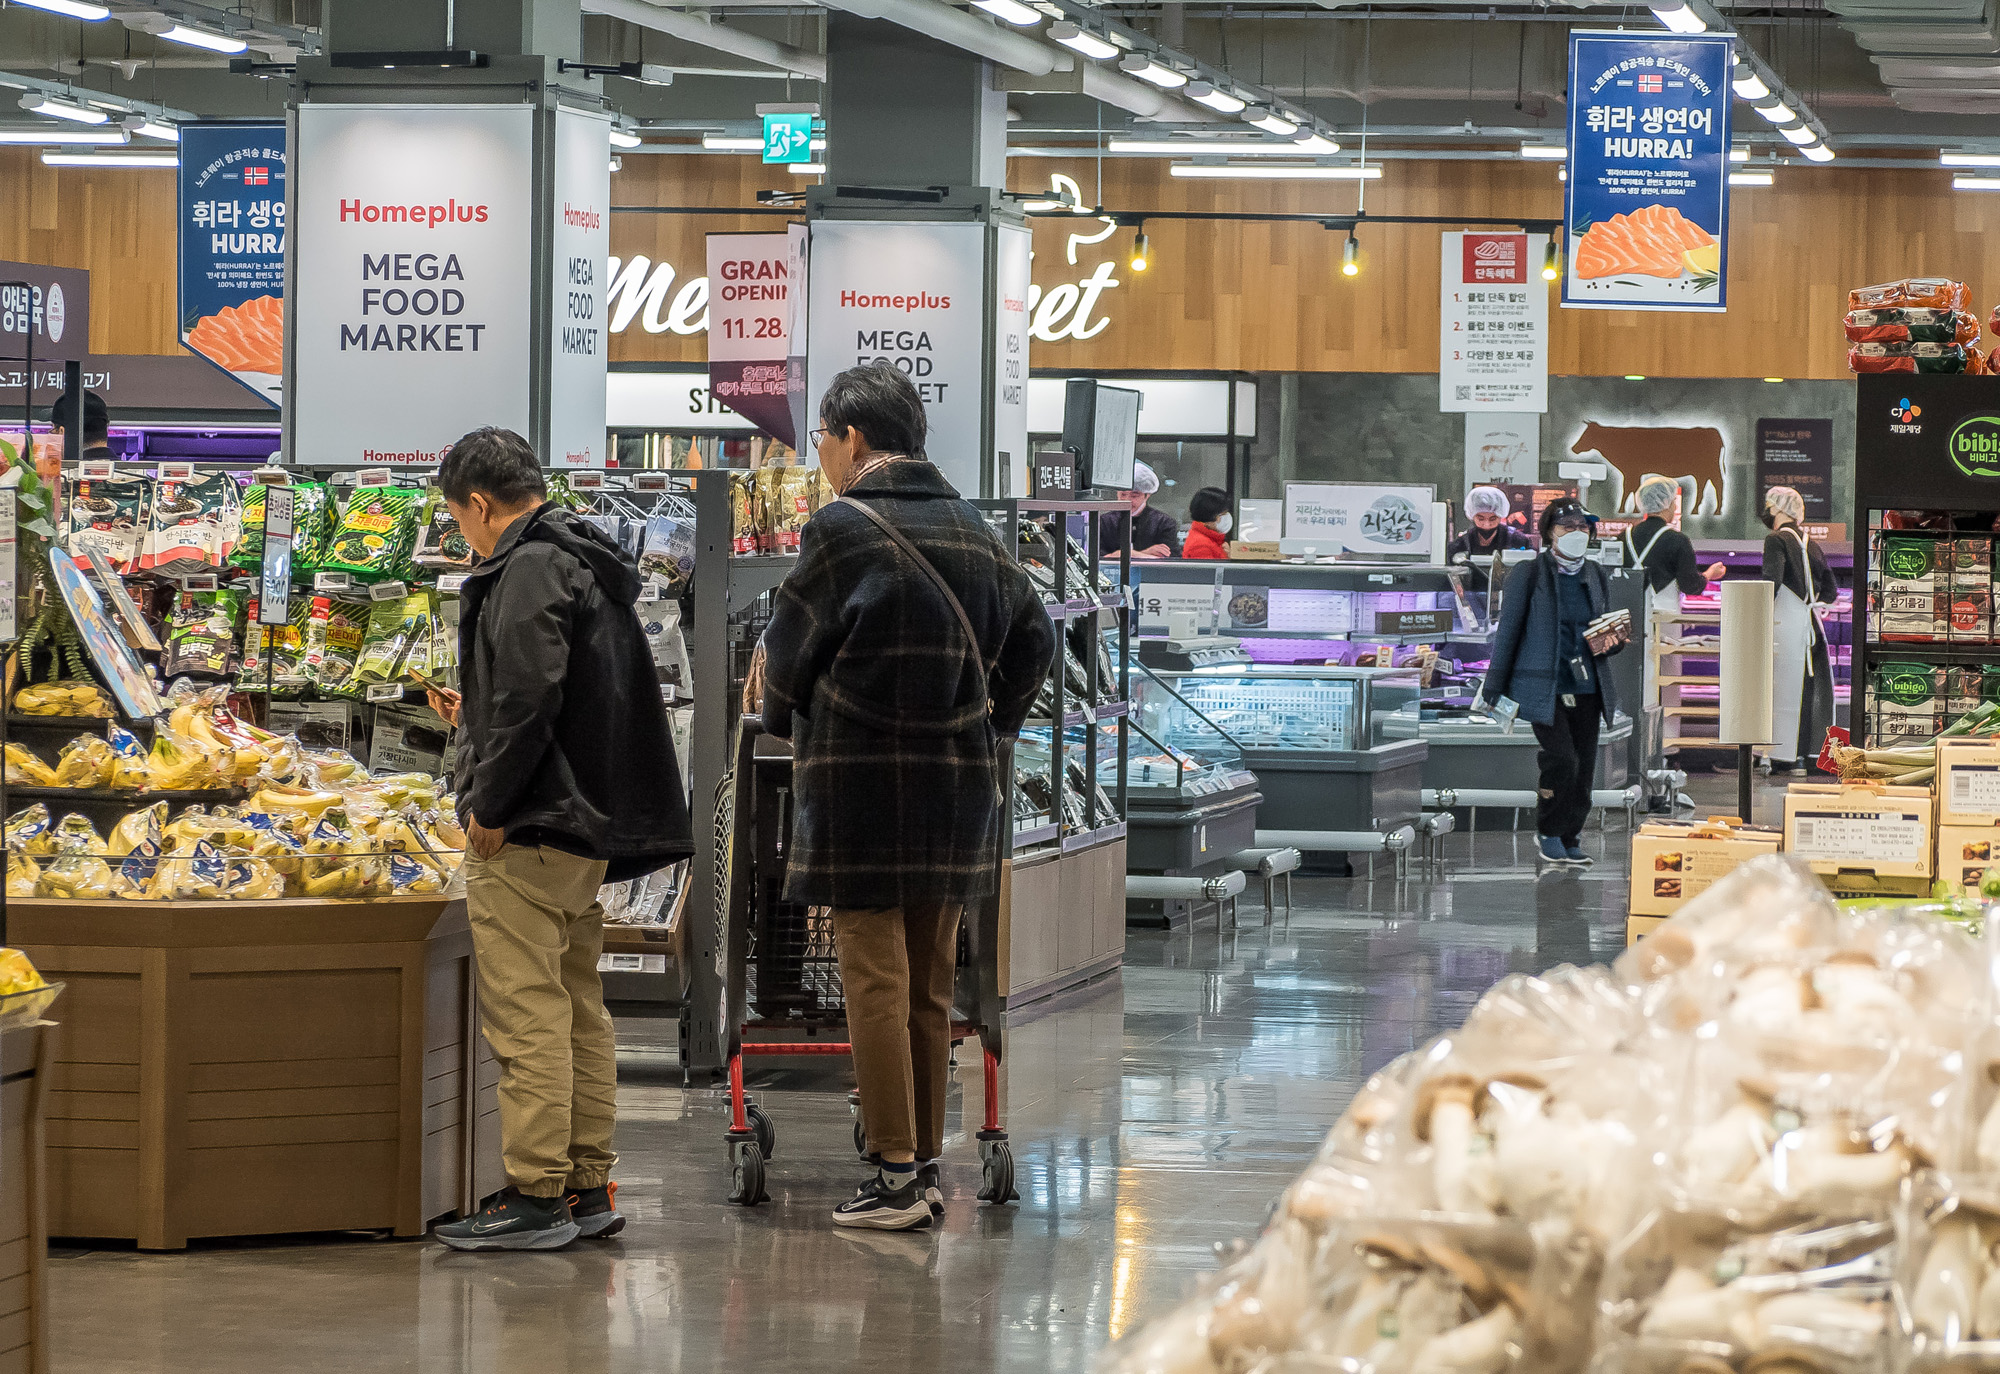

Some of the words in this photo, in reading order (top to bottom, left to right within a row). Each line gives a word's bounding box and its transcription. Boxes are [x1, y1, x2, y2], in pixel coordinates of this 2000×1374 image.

[1590, 65, 1621, 94] 노르웨이
[1619, 56, 1655, 72] 항공직송
[1656, 57, 1691, 78] 콜드체인
[1689, 73, 1711, 97] 생연어
[1586, 105, 1636, 133] 휘라
[1639, 107, 1712, 136] 생연어
[1604, 137, 1693, 159] HURRA!
[195, 158, 225, 188] 노르웨이
[224, 148, 260, 163] 항공직송
[192, 200, 242, 229] 휘라
[339, 198, 489, 229] Homeplus
[564, 202, 600, 233] Homeplus
[363, 253, 465, 281] MEGA
[568, 257, 593, 286] MEGA
[720, 260, 788, 281] GRAN
[362, 288, 465, 316] FOOD
[607, 255, 710, 335] Me
[840, 290, 951, 313] Homeplus
[1454, 293, 1463, 302] 1.
[1468, 292, 1485, 302] 클럽
[1488, 292, 1506, 302] 단독
[1509, 292, 1526, 302] 할인
[568, 292, 593, 320] FOOD
[1453, 321, 1464, 331] 2.
[1468, 321, 1485, 331] 클럽
[1488, 321, 1505, 331] 전용
[1508, 321, 1534, 331] 이벤트
[340, 323, 486, 351] MARKET
[562, 328, 598, 356] MARKET
[857, 330, 933, 351] MEGA
[1454, 350, 1464, 360] 3.
[1467, 350, 1493, 360] 다양한
[1497, 350, 1514, 360] 정보
[1517, 350, 1534, 360] 제공
[717, 381, 739, 396] 메가
[740, 381, 763, 396] 푸드
[1891, 407, 1904, 418] CJ
[1890, 424, 1922, 434] 제일제당
[1958, 432, 2000, 452] bibi
[363, 449, 436, 465] Homeplus
[1969, 453, 1998, 463] 비비고
[1040, 466, 1053, 489] 진도
[1053, 466, 1071, 490] 특산물
[1296, 505, 1321, 516] 지리산
[1310, 516, 1326, 525] 우리
[1364, 508, 1418, 530] 지리산
[354, 515, 390, 529] 자른미역
[1893, 554, 1924, 567] bibigo
[1890, 597, 1926, 609] 참기름김
[1894, 681, 1924, 693] bibigo
[1889, 723, 1924, 735] 참기름김
